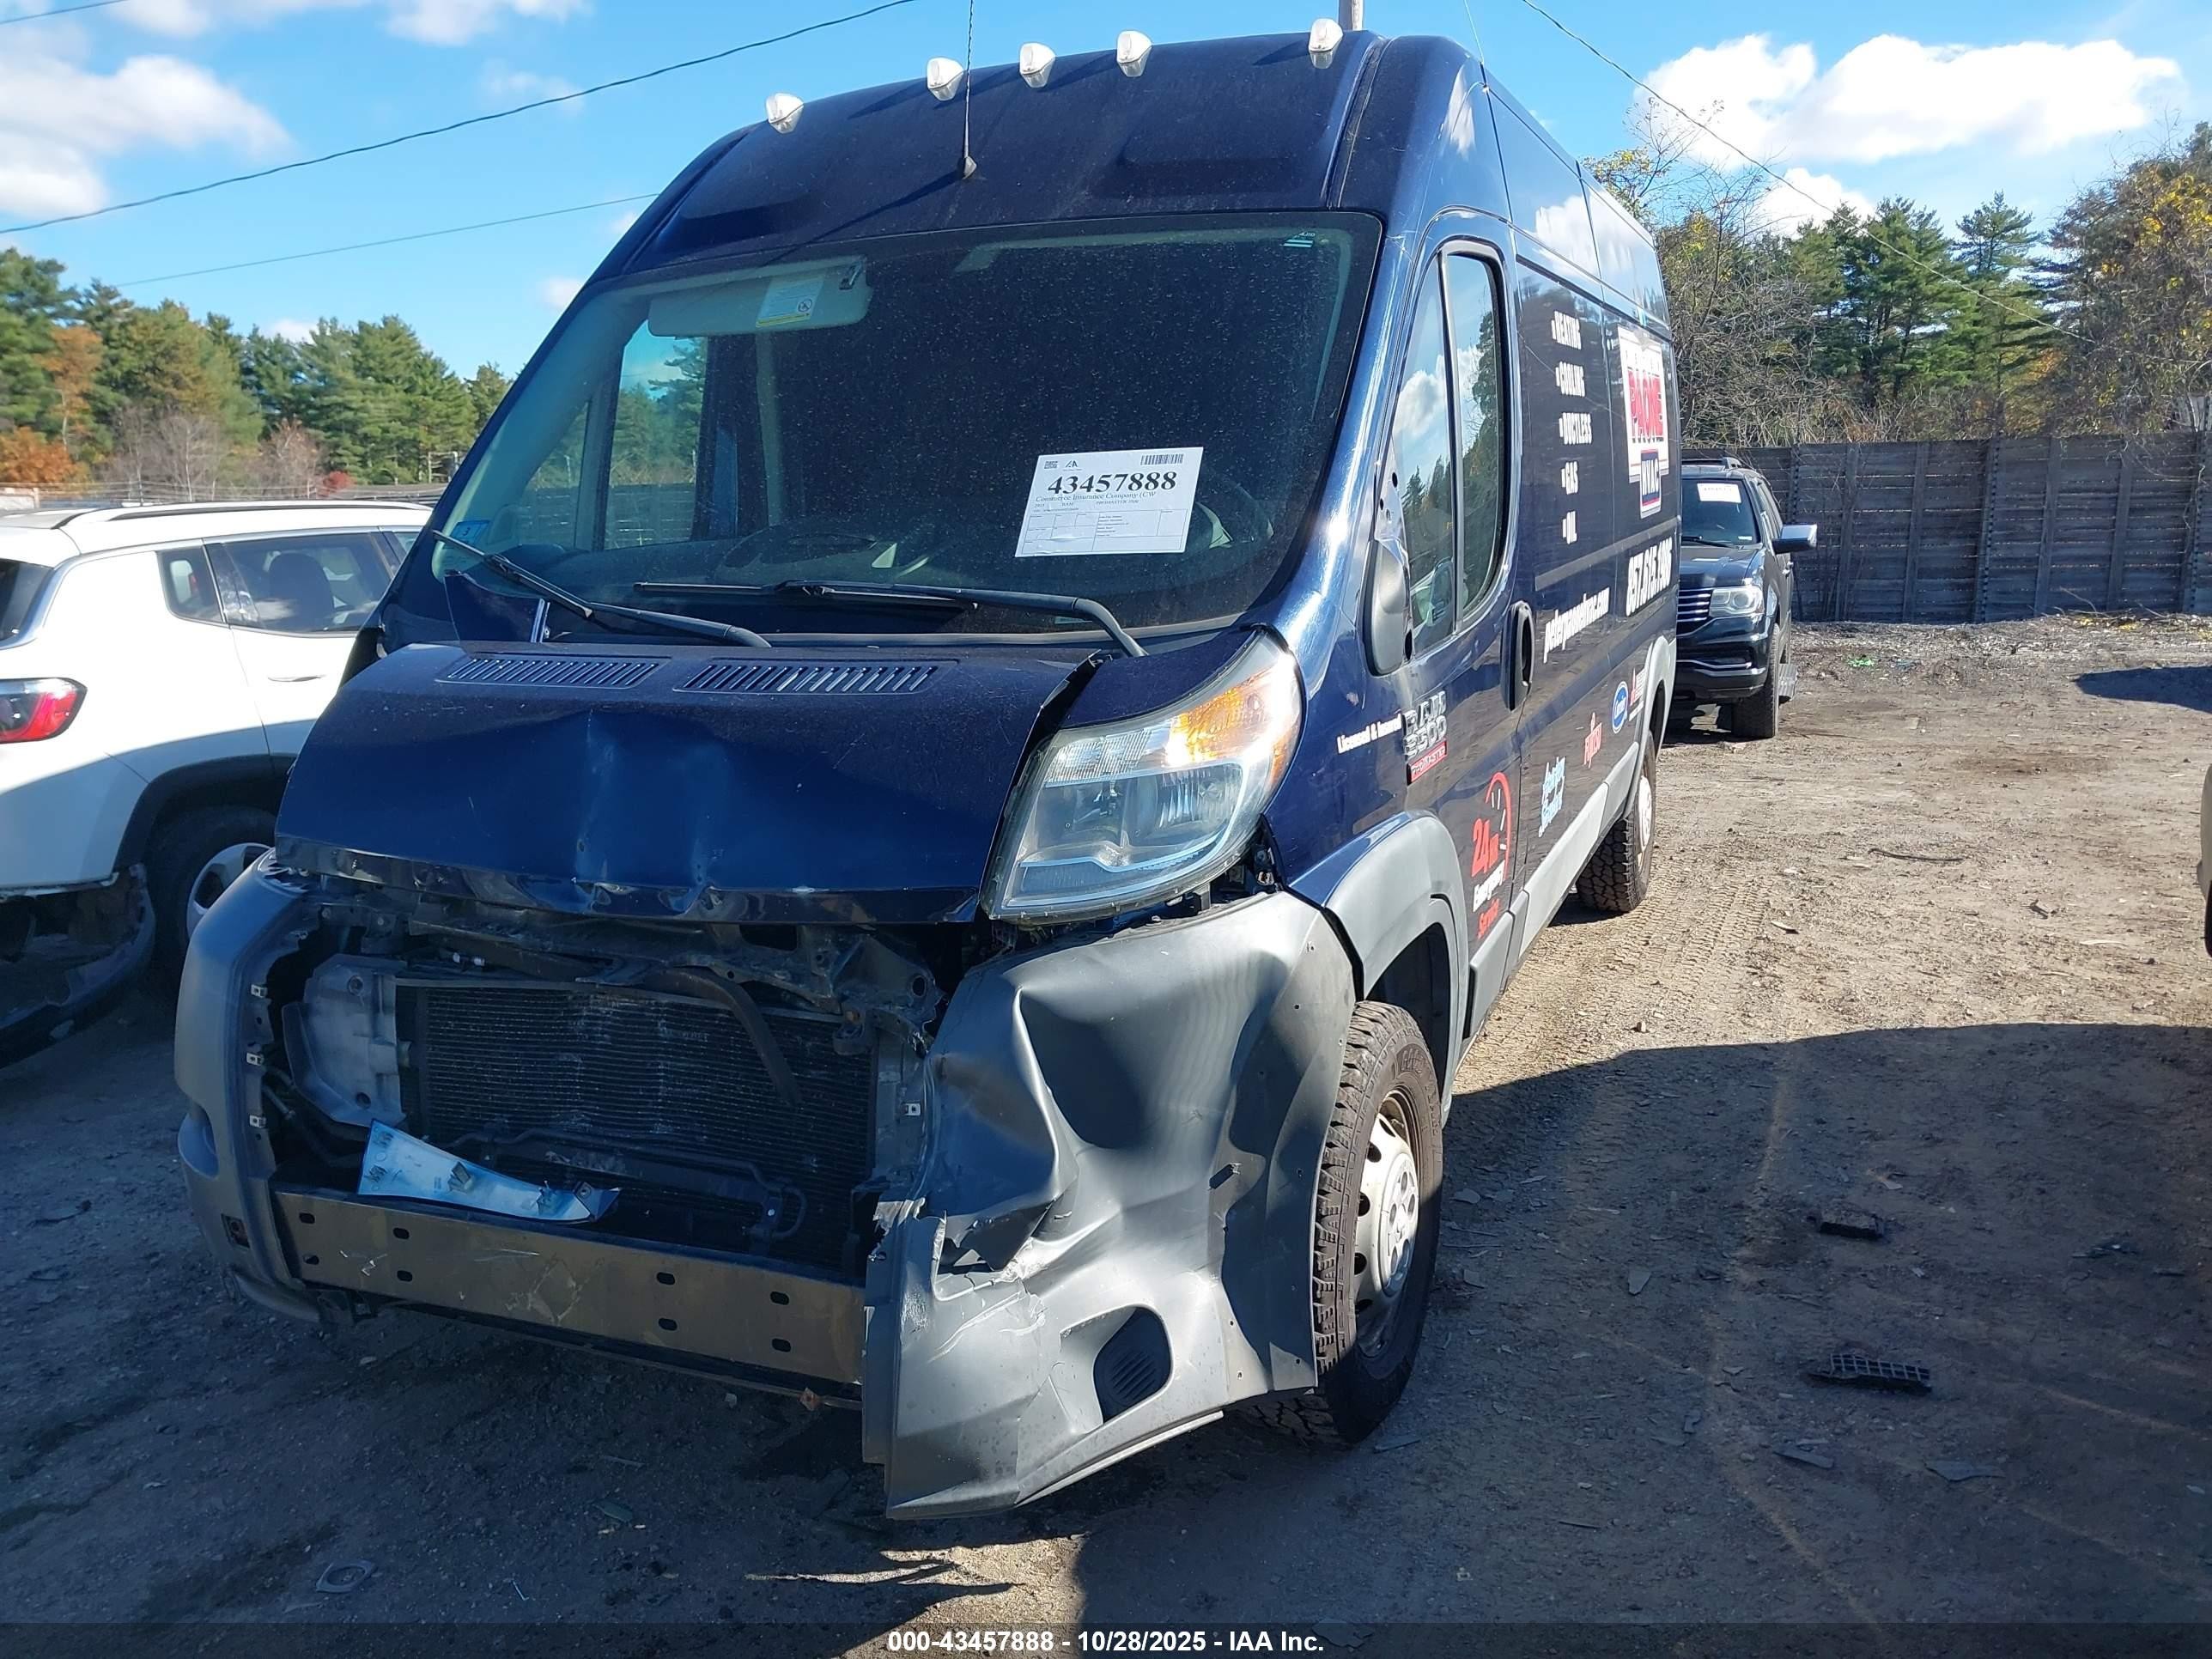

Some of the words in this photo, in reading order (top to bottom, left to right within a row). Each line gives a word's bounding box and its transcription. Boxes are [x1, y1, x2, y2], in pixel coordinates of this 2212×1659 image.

[1554, 311, 1582, 349] HEATING
[1559, 362, 1585, 397] COOLING
[1562, 412, 1592, 445] DUCTLESS
[1048, 471, 1177, 495] 43457888
[1565, 461, 1578, 495] GAS
[1641, 458, 1660, 495] HVAC
[1566, 510, 1577, 544] OIL
[1402, 690, 1447, 733] RAM
[1337, 725, 1371, 754] Licensed
[1370, 723, 1378, 741] &
